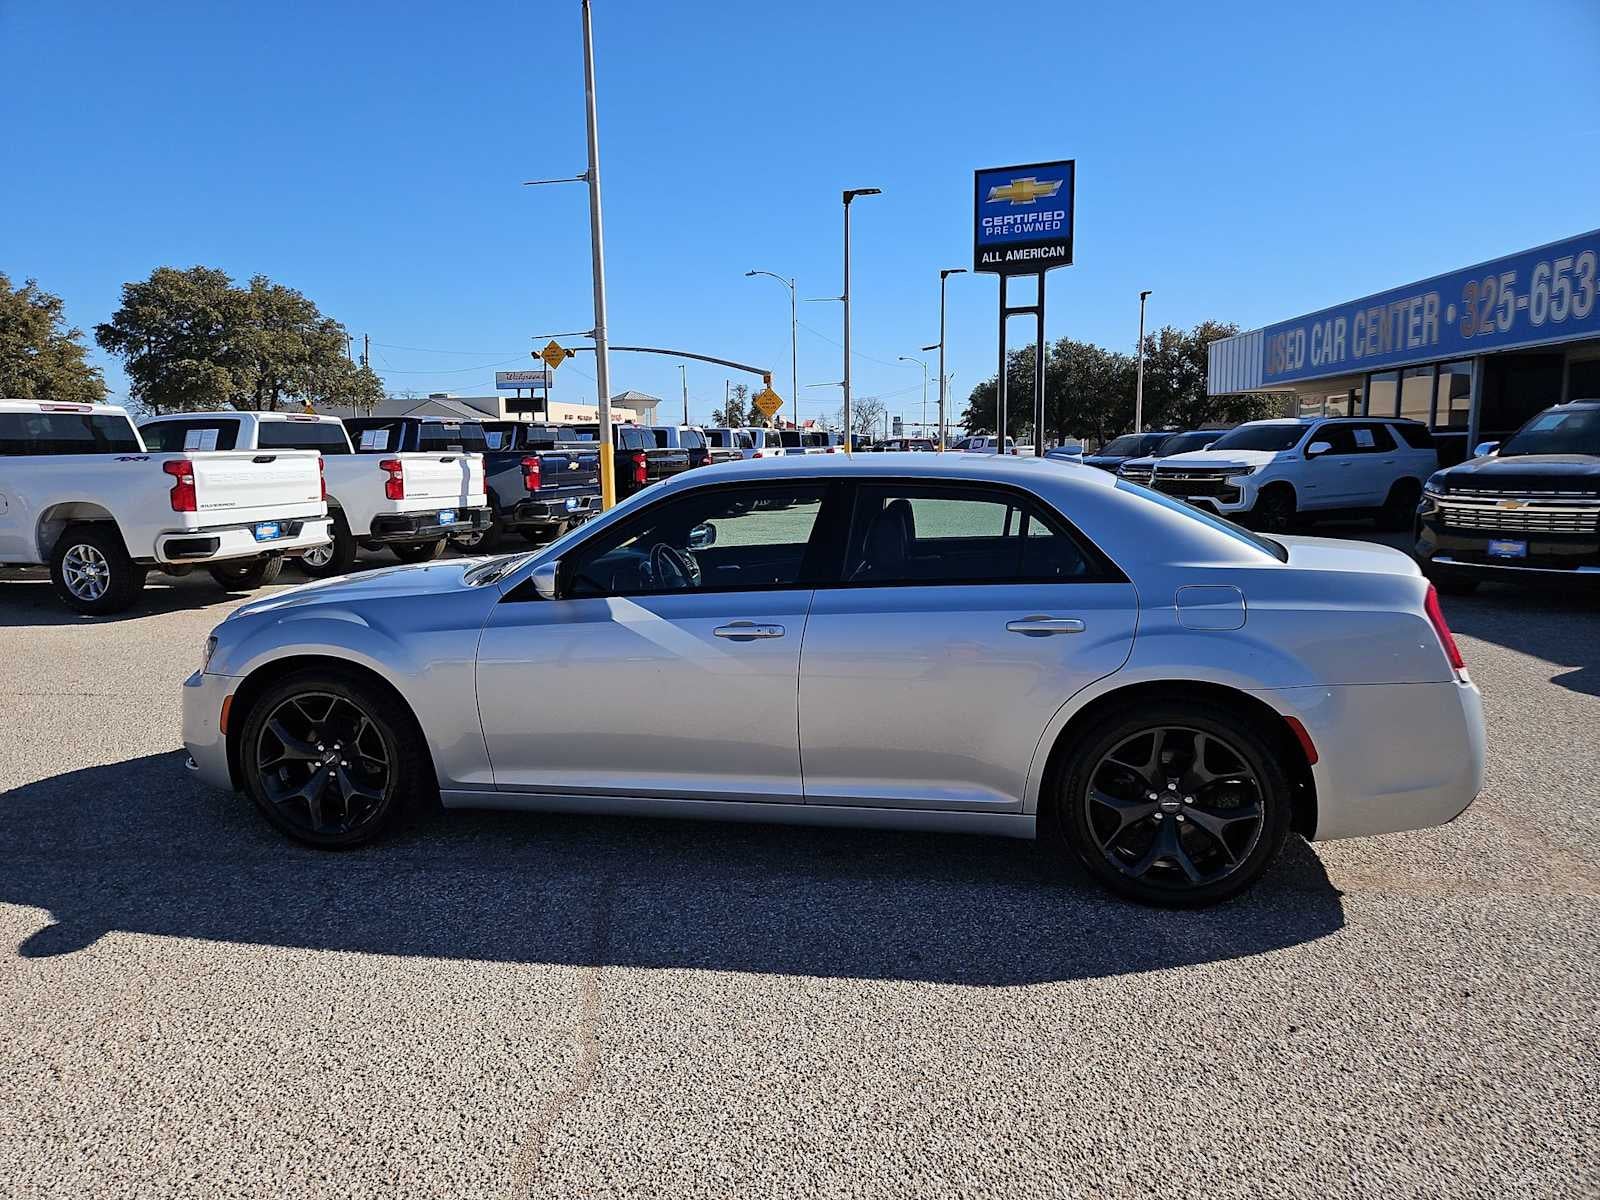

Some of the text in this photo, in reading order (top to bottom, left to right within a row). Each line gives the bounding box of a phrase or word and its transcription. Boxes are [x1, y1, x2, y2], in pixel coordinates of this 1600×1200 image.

[982, 210, 1065, 227] CERTIFIED
[986, 221, 1061, 236] PRE-OWNED
[982, 246, 1065, 263] ALL AMERICAN
[1264, 328, 1306, 376] USED
[1311, 316, 1347, 367] CAR
[1352, 291, 1441, 360] CENTER
